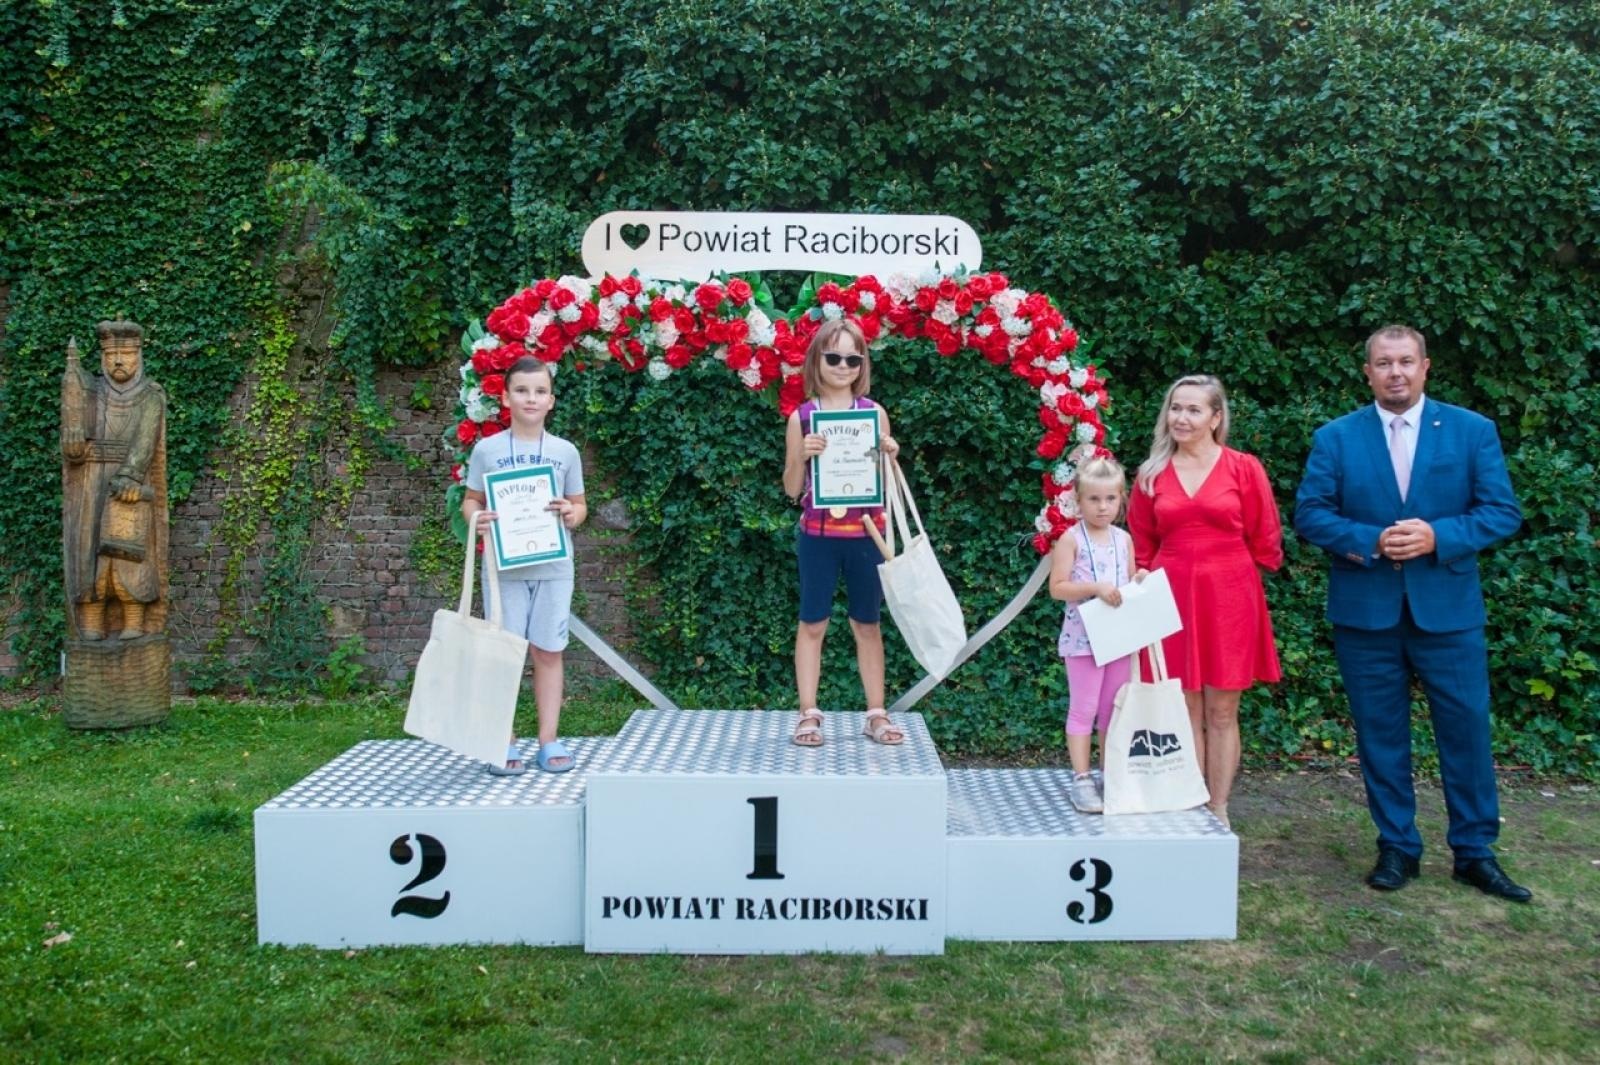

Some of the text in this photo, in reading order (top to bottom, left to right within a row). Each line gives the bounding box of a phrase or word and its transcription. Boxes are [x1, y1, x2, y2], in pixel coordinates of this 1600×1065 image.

[605, 223, 960, 256] I Powiat Raciborski
[746, 796, 785, 880] 1
[389, 833, 451, 919] 2
[601, 896, 929, 921] POWIAT RACIBORSKI
[1066, 857, 1113, 925] 3
